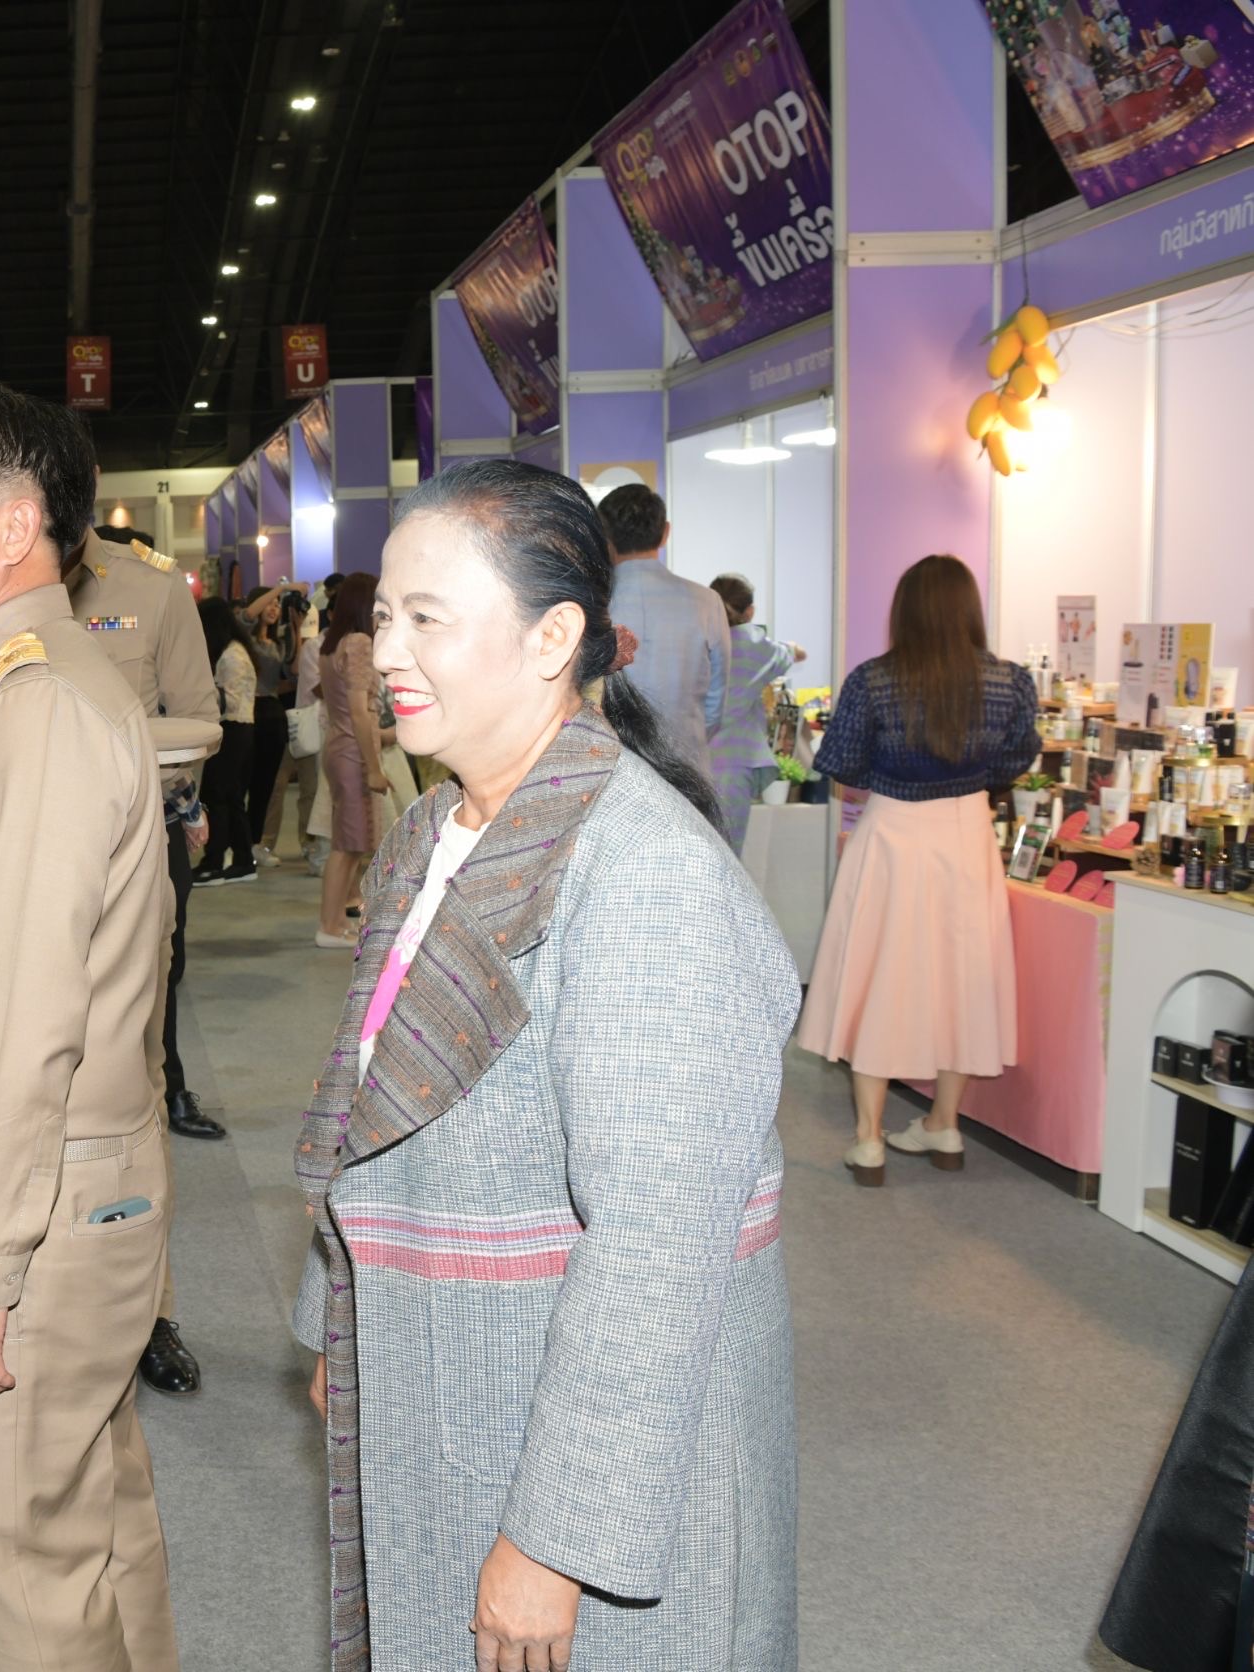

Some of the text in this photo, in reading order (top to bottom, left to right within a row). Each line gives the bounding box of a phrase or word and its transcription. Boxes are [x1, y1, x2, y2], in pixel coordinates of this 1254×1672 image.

[714, 90, 808, 195] OTOP
[81, 373, 96, 392] T
[297, 363, 315, 383] U
[157, 480, 169, 493] 21
